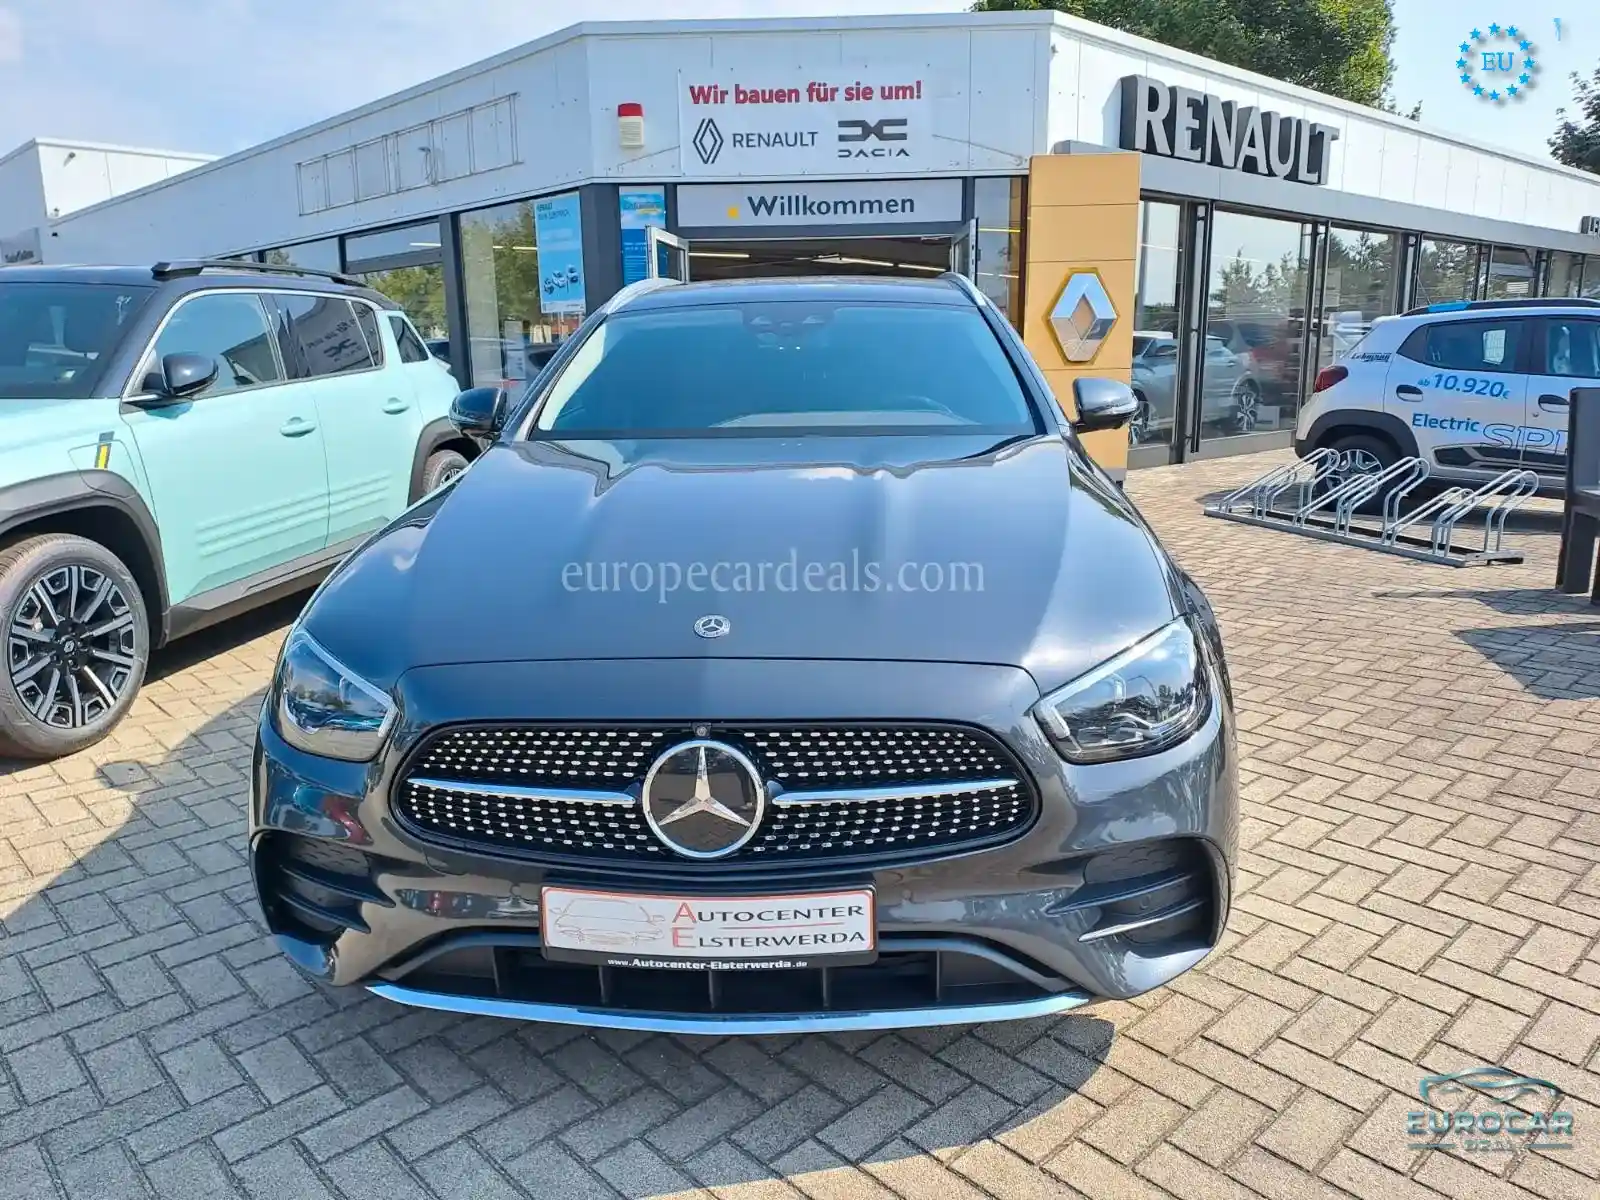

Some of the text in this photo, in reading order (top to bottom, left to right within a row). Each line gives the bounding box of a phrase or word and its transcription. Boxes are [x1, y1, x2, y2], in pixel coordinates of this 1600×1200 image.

[689, 80, 922, 105] Wir bauen für sie um!
[732, 131, 819, 148] RENAULT
[1122, 74, 1340, 185] RENAULT
[837, 148, 910, 158] DACIA
[747, 194, 915, 217] Willkommen
[1412, 413, 1480, 433] Electric
[607, 958, 808, 970] www.Autocenter-Elsterwerda.de
